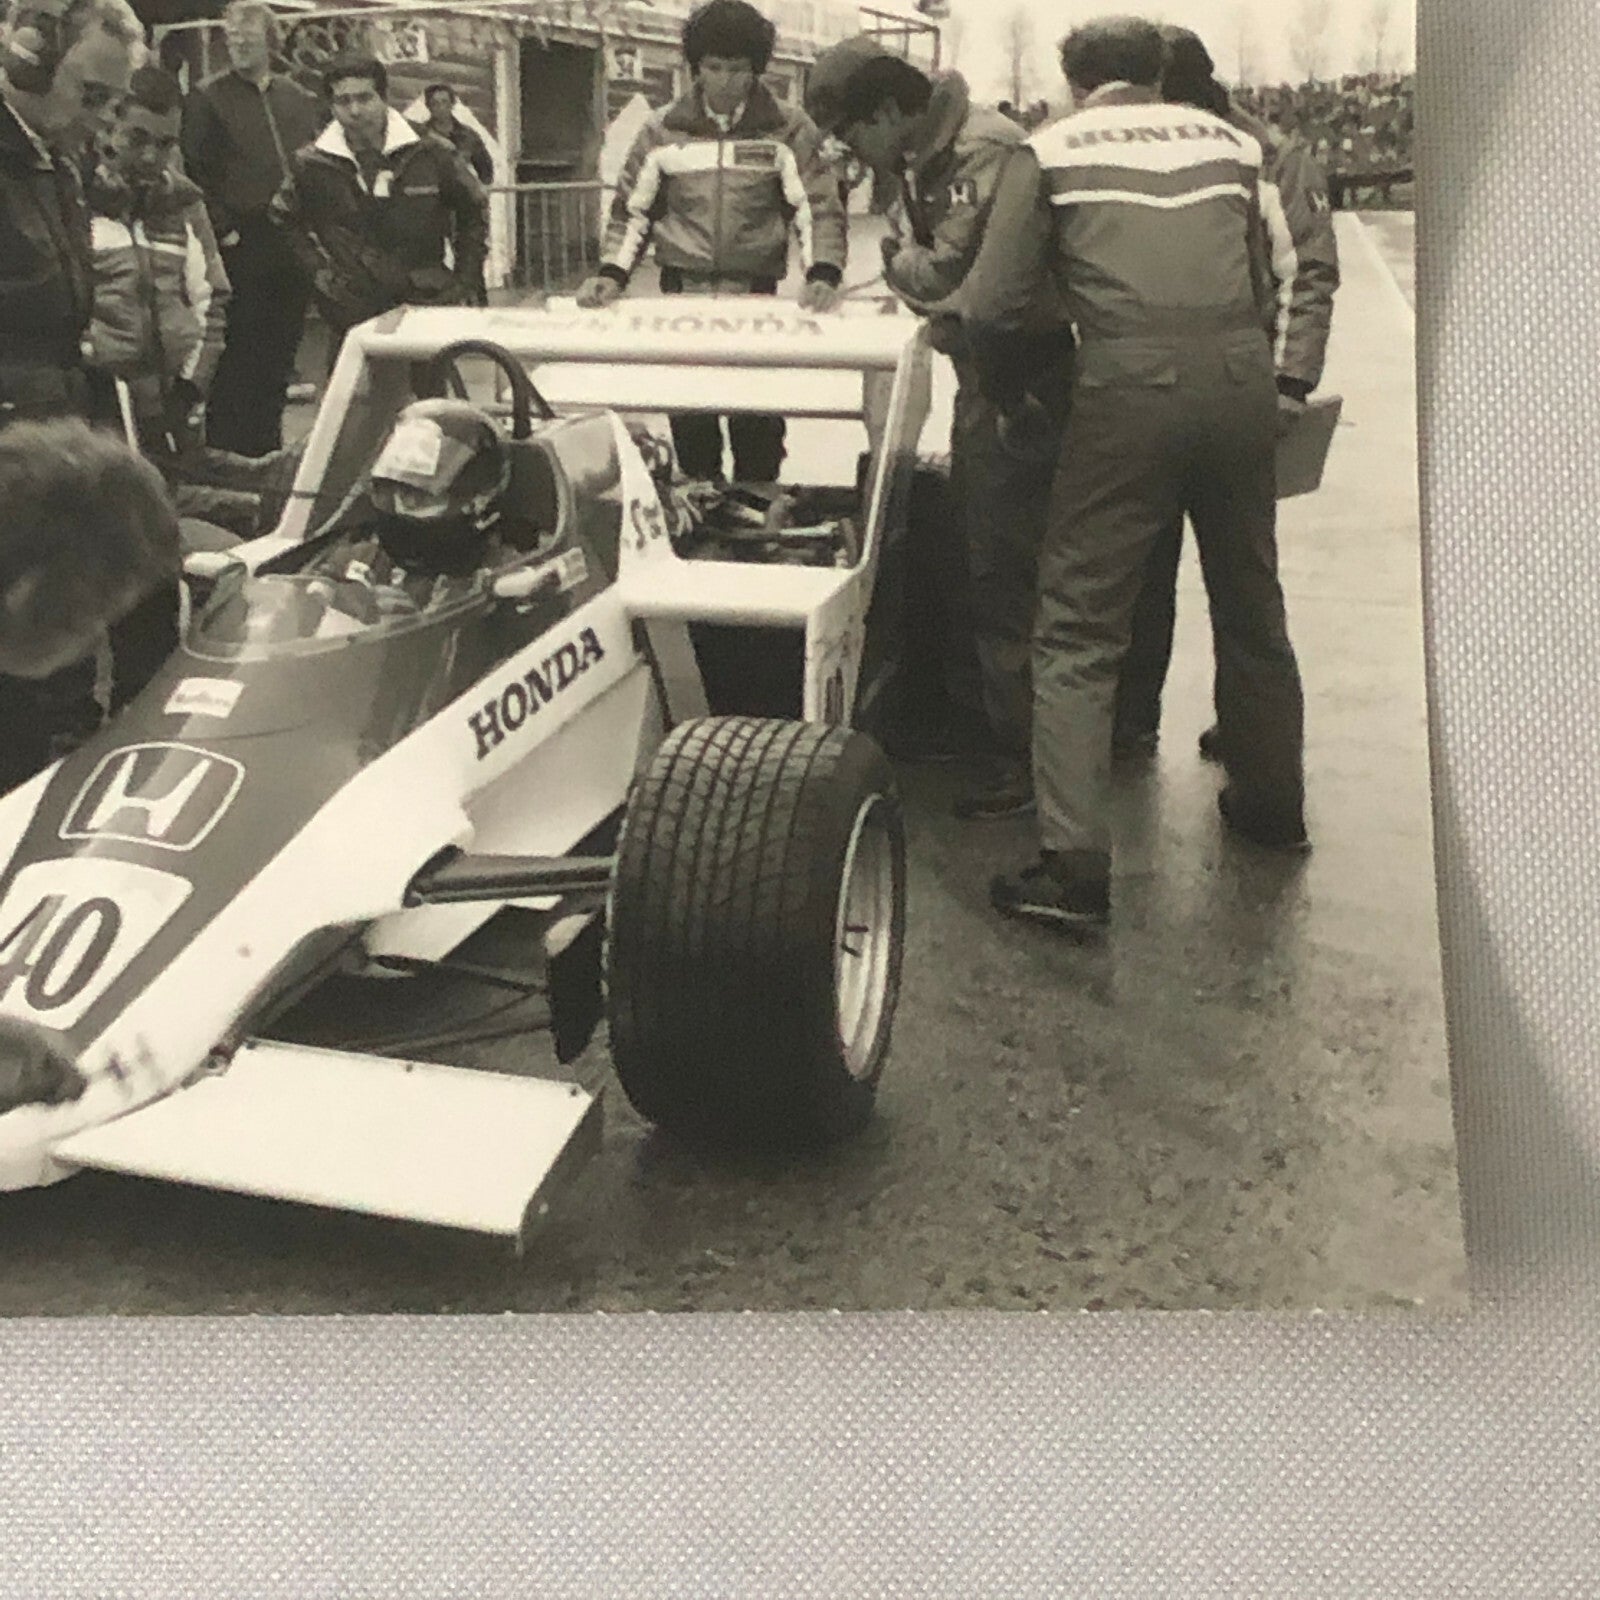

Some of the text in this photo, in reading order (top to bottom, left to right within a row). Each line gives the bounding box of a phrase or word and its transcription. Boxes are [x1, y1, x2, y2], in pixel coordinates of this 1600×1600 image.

[1066, 123, 1242, 149] HONDA
[629, 314, 824, 337] HONDA
[467, 627, 604, 761] HONDA
[0, 893, 122, 1012] 40
